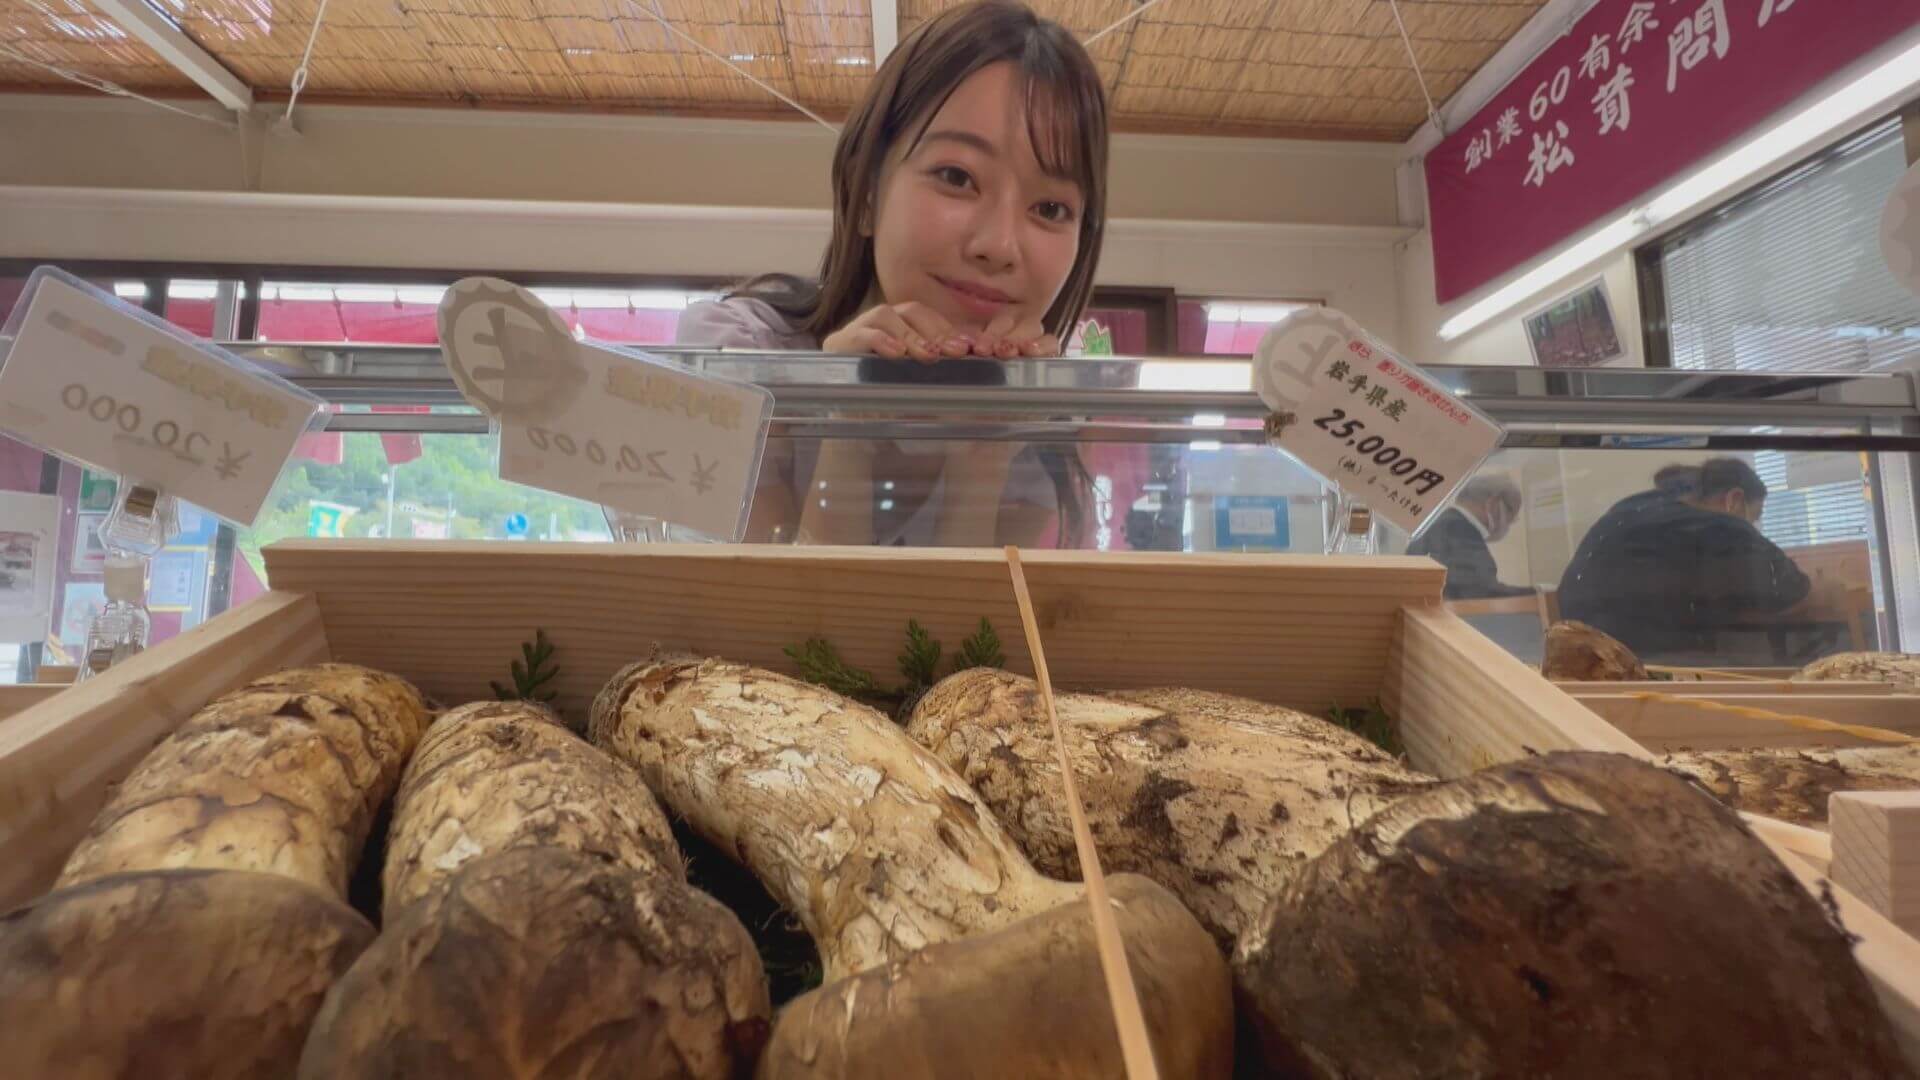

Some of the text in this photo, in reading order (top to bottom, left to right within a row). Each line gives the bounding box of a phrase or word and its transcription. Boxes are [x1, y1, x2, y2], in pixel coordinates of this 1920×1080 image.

[1465, 0, 1677, 173] 創業60有余
[1325, 359, 1408, 422] 岩手県産
[1314, 408, 1444, 495] 25,000円
